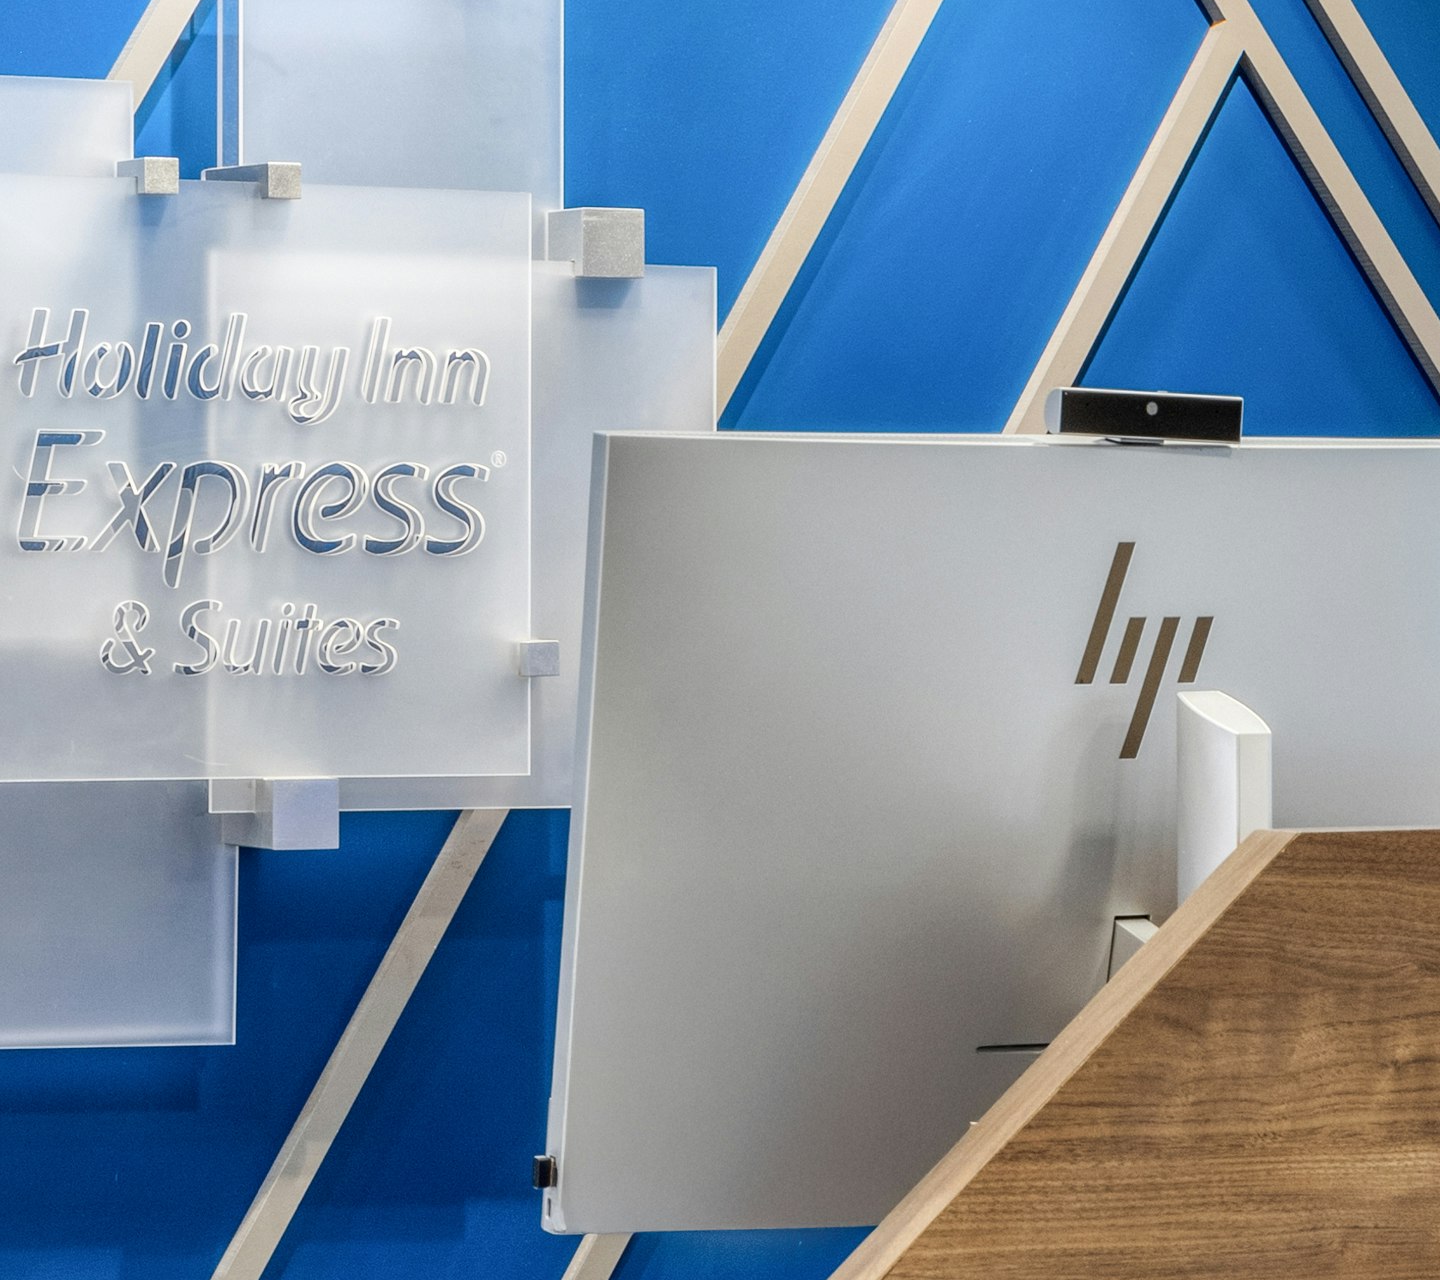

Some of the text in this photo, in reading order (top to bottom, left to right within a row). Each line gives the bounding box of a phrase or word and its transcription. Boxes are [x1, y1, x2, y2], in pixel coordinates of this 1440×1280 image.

[14, 307, 492, 426] Holiday Inn
[100, 599, 401, 677] & Suites
[1073, 541, 1215, 760] hp
